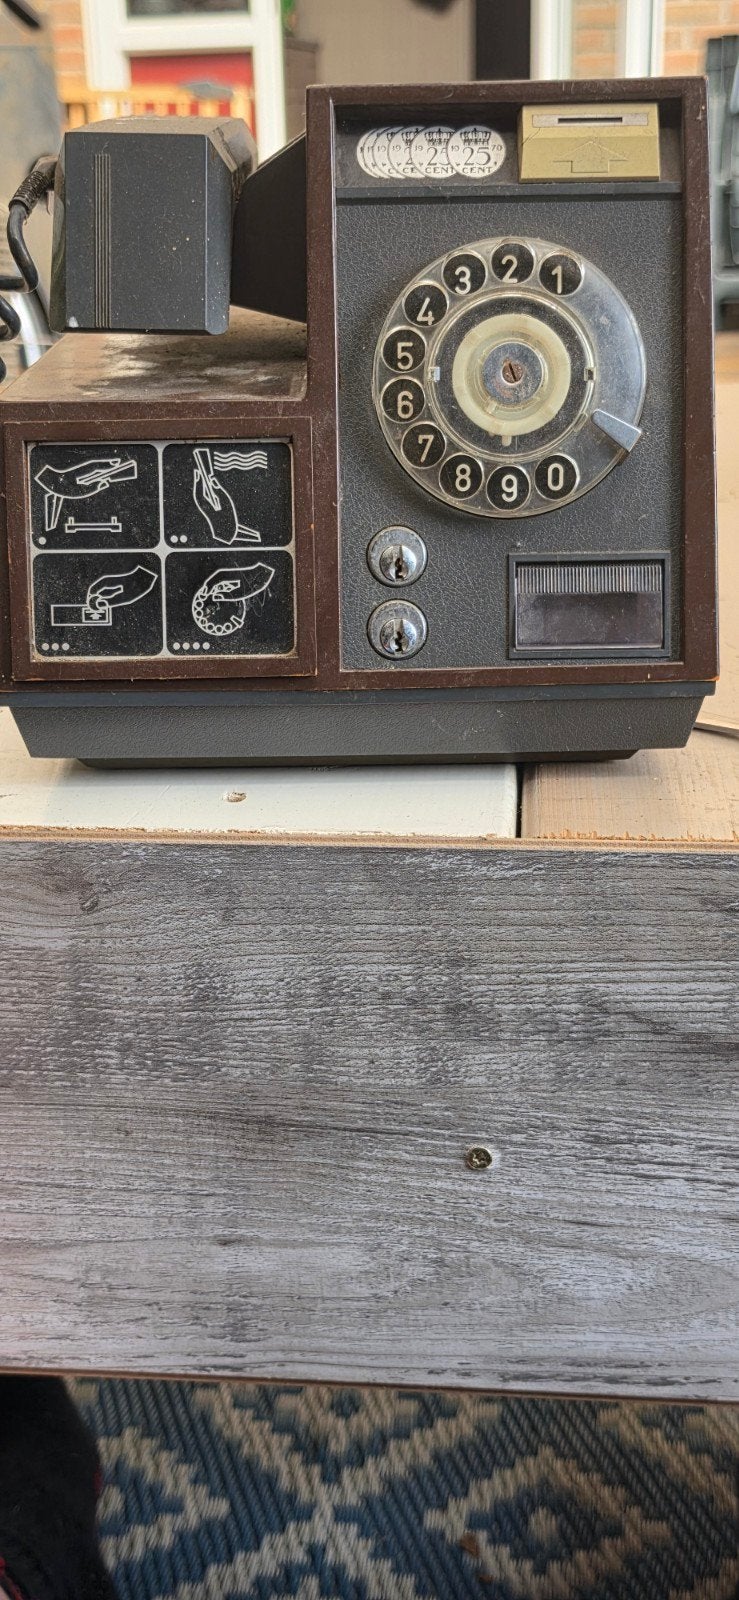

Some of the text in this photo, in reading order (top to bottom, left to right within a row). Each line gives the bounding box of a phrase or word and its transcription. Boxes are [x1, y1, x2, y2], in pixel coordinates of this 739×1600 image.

[462, 146, 491, 166] 25
[462, 166, 493, 174] CENT
[454, 266, 471, 295] 3
[501, 254, 518, 283] 2
[551, 265, 562, 294] 1
[416, 297, 435, 326] 4
[397, 342, 414, 370] 5
[397, 390, 414, 419] 6
[417, 434, 434, 463] 7
[455, 463, 472, 492] 8
[501, 474, 518, 503] 9
[547, 463, 564, 491] 0
